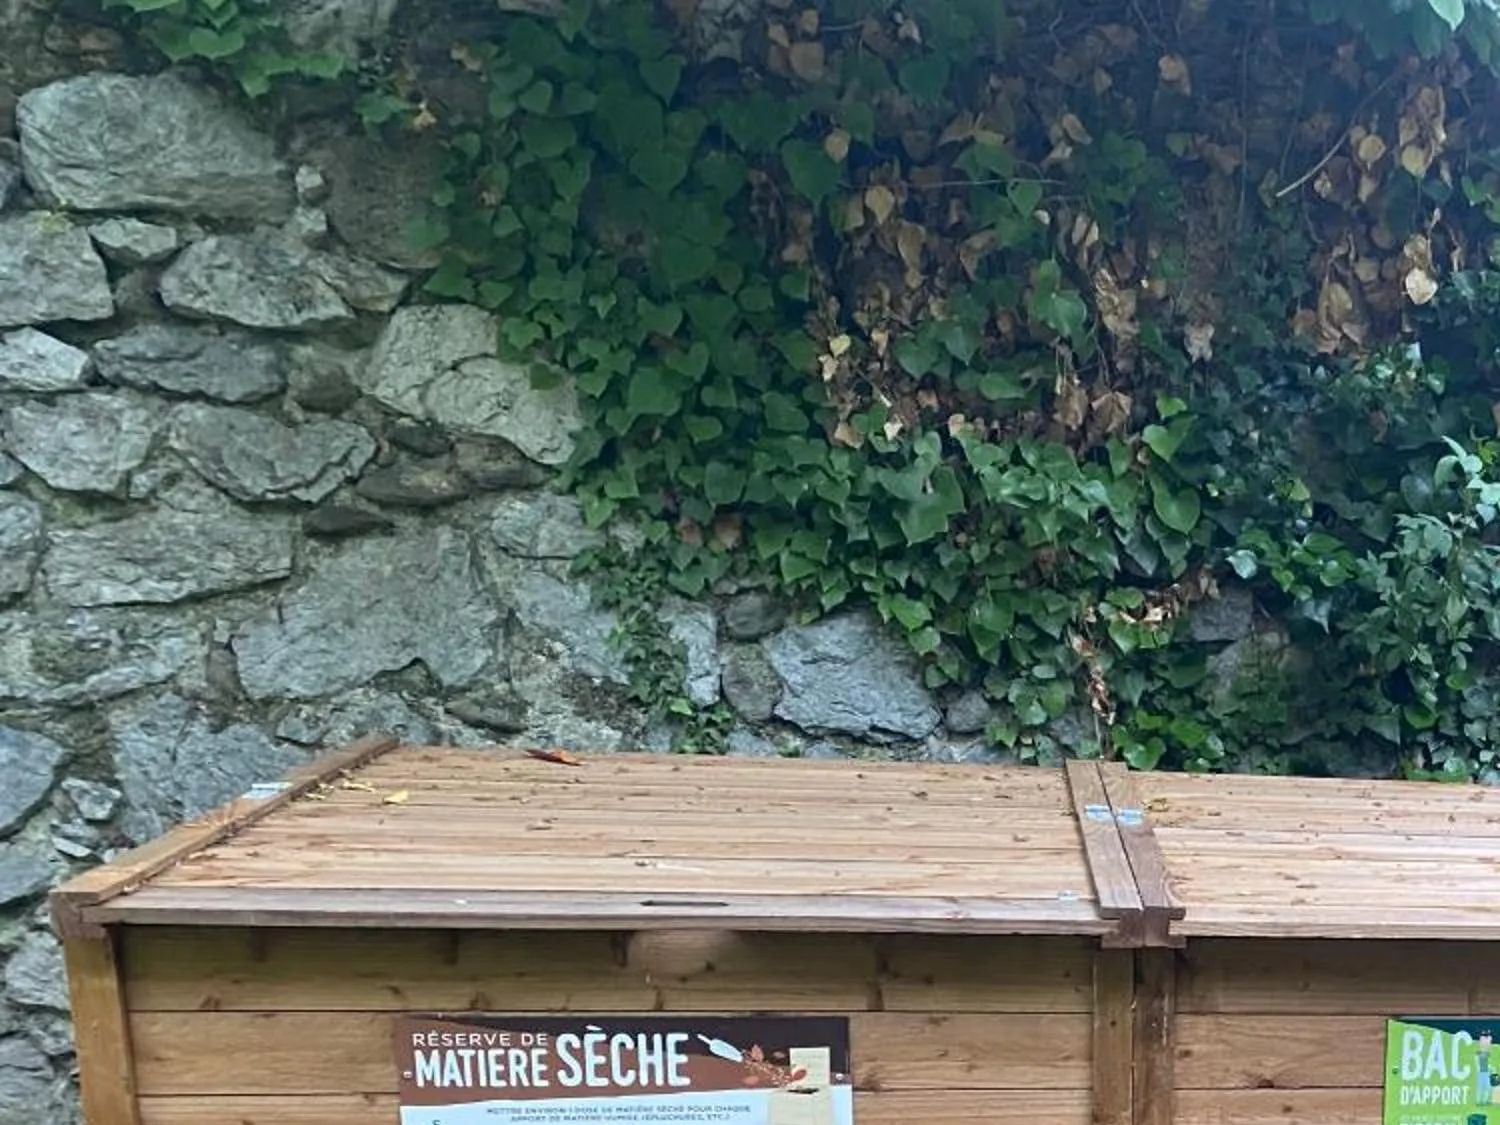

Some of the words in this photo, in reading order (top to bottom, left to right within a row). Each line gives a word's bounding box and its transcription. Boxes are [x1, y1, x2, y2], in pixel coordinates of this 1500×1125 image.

[412, 1030, 511, 1047] RÉSERVE
[521, 1033, 549, 1047] DE
[555, 1024, 691, 1087] SÈCHE
[1402, 1029, 1473, 1080] BAC
[1400, 1085, 1470, 1105] D'APPORT
